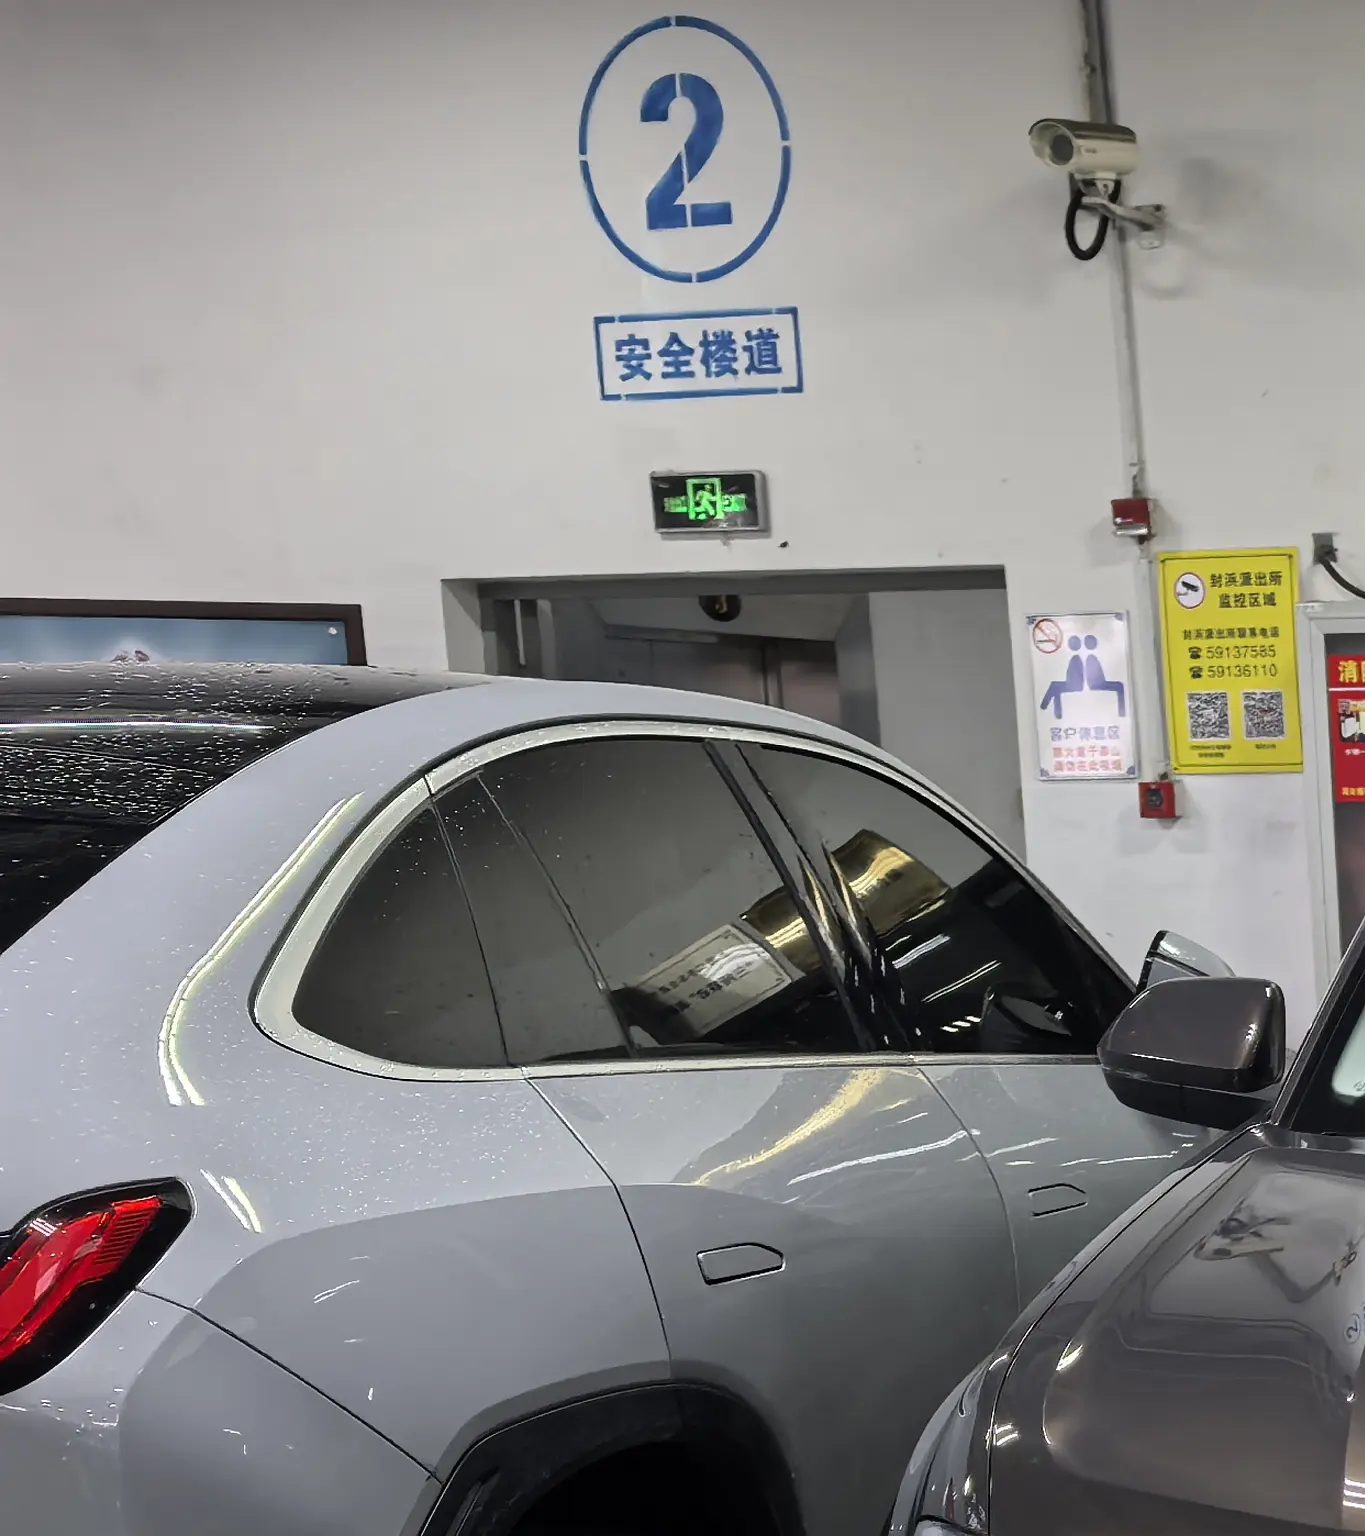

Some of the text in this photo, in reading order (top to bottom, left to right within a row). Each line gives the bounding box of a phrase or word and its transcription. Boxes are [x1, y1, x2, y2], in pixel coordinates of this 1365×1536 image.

[640, 72, 732, 230] 2
[614, 328, 782, 383] 安全楼道
[1219, 592, 1276, 608] 监控区域
